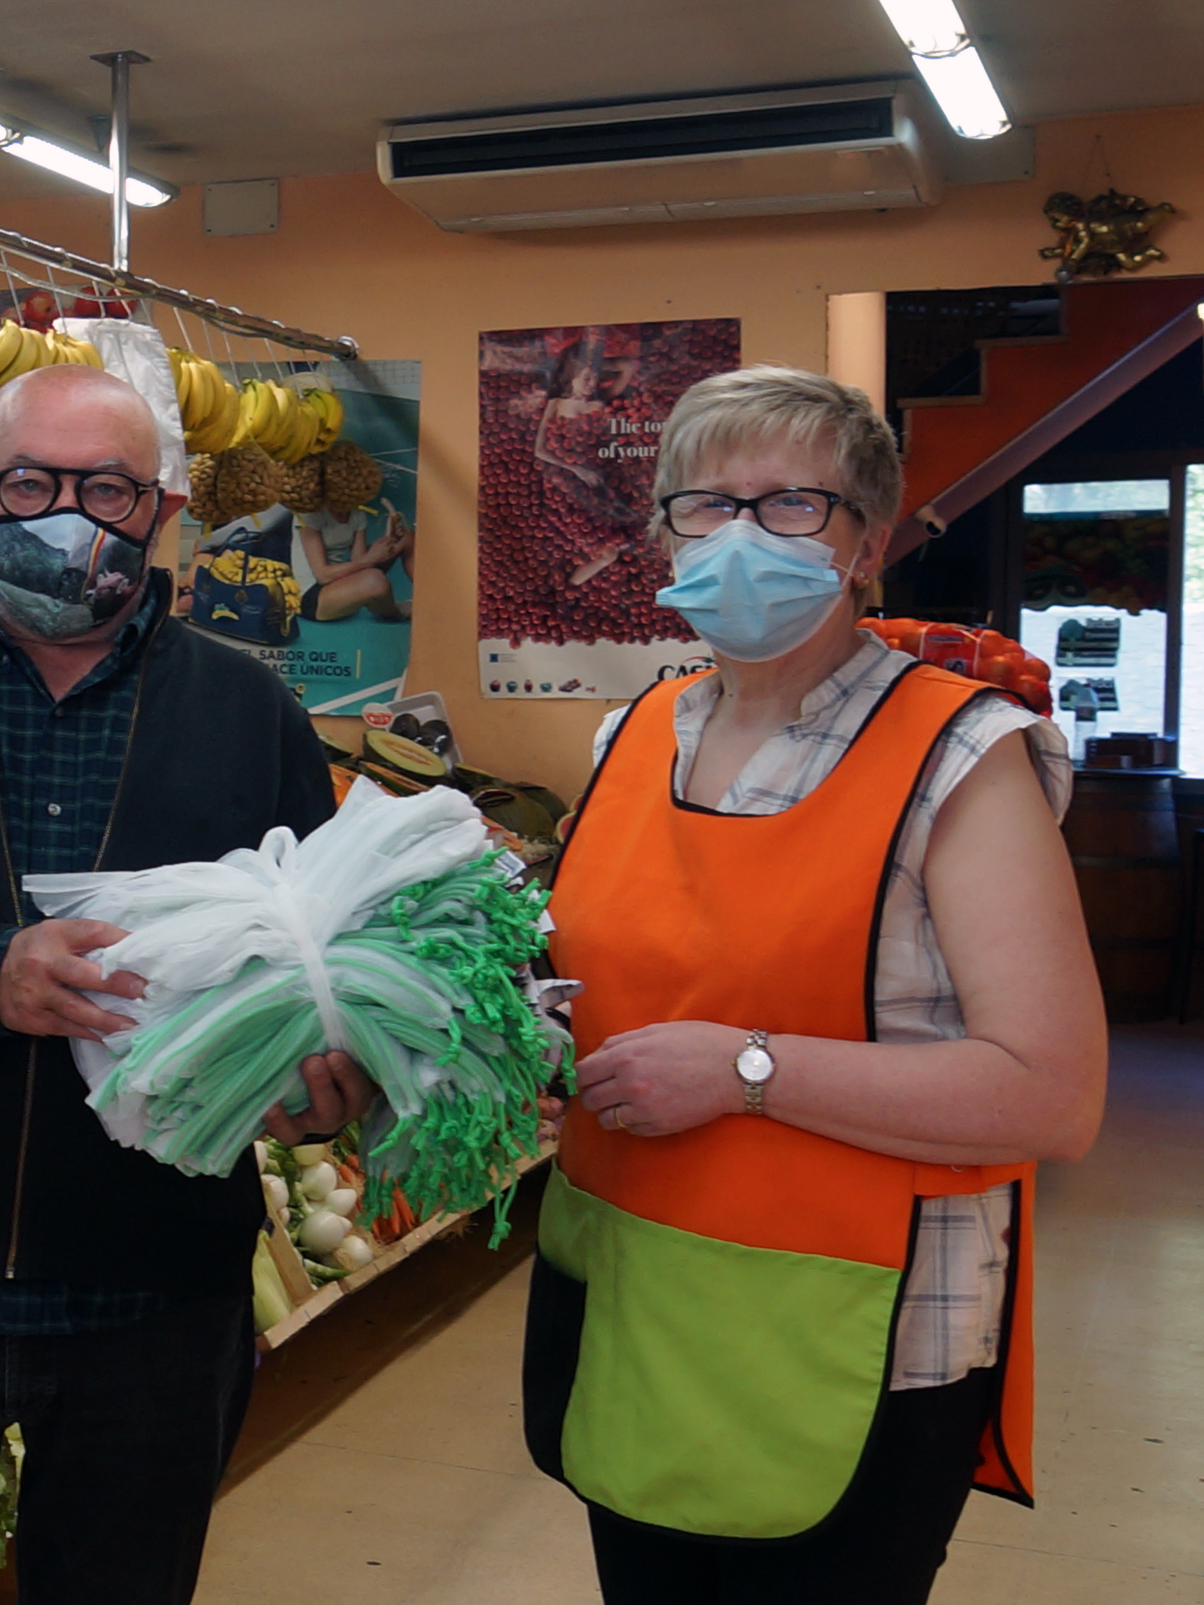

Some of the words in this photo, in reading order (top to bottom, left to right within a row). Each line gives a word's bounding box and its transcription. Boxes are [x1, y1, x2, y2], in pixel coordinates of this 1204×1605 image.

[607, 418, 641, 434] The
[644, 420, 667, 433] to
[598, 442, 618, 458] of
[617, 446, 658, 463] your
[259, 650, 305, 661] SABOR
[309, 651, 338, 662] QUE
